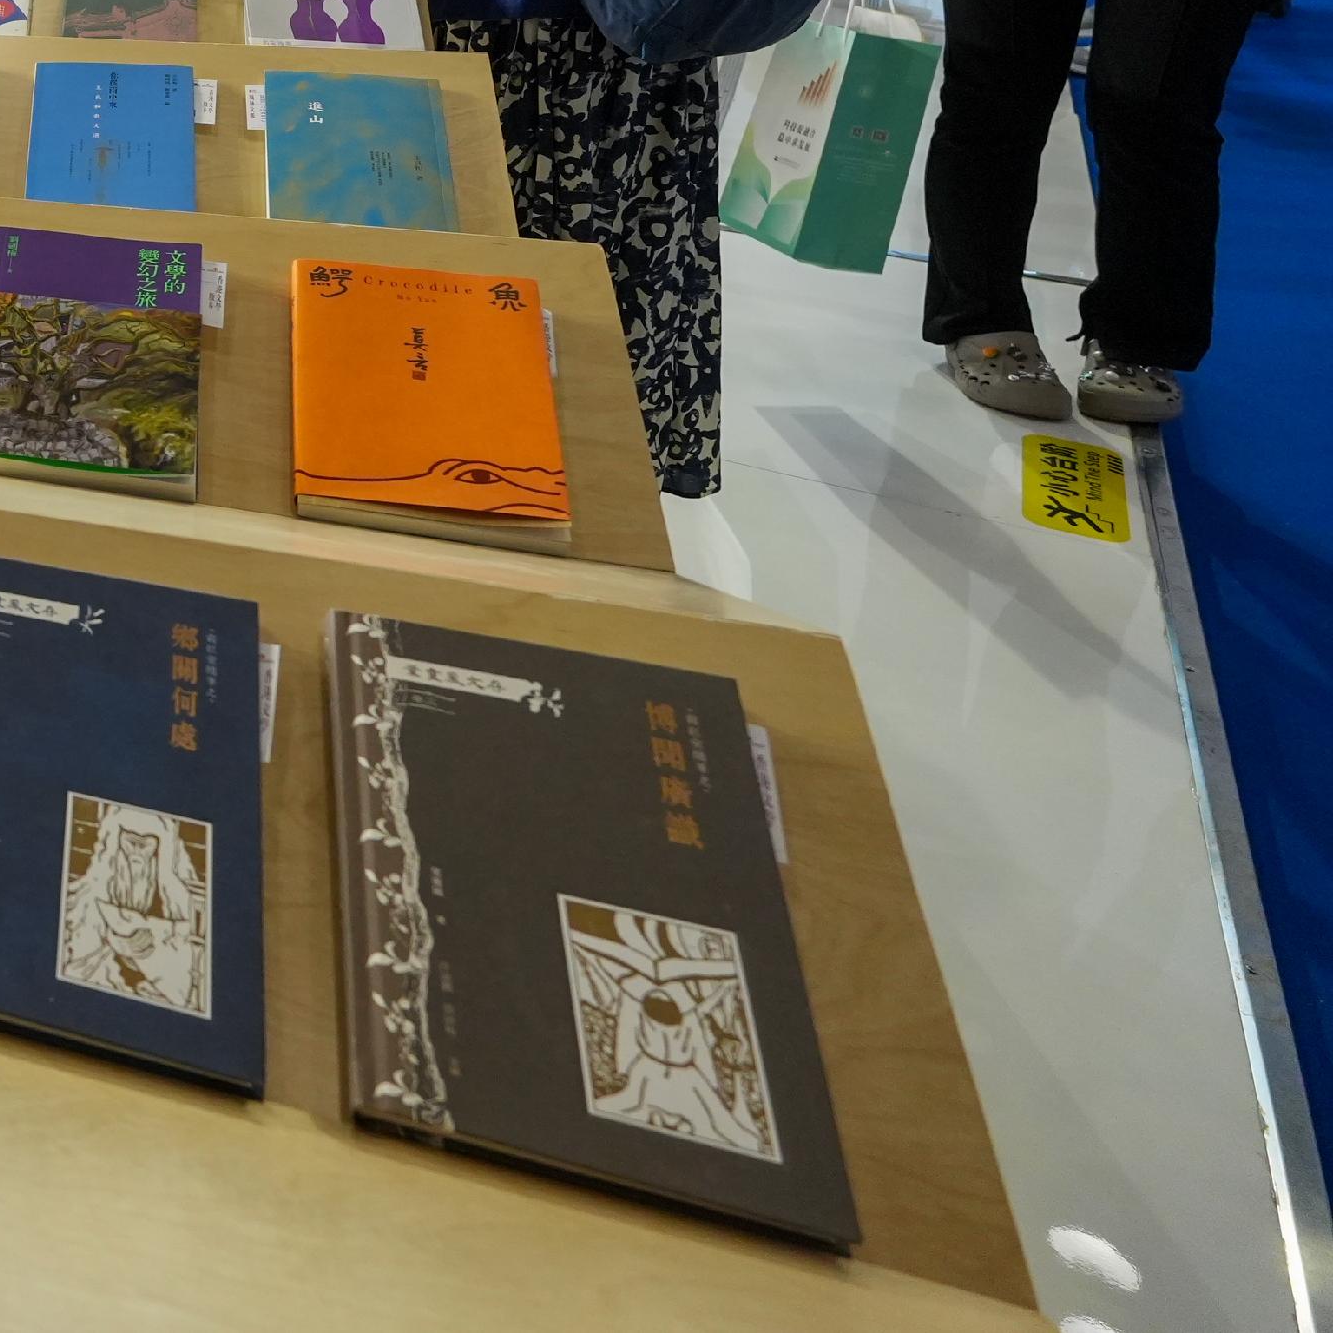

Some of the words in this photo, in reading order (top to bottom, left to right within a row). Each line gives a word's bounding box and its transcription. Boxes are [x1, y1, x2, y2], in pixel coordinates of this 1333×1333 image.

[134, 248, 160, 307] 變幻之旅
[164, 249, 188, 295] 文學的
[362, 274, 474, 296] Crocodile
[488, 282, 529, 312] 魚
[1083, 451, 1104, 467] Step
[1084, 468, 1101, 482] The
[1085, 481, 1102, 502] Mind
